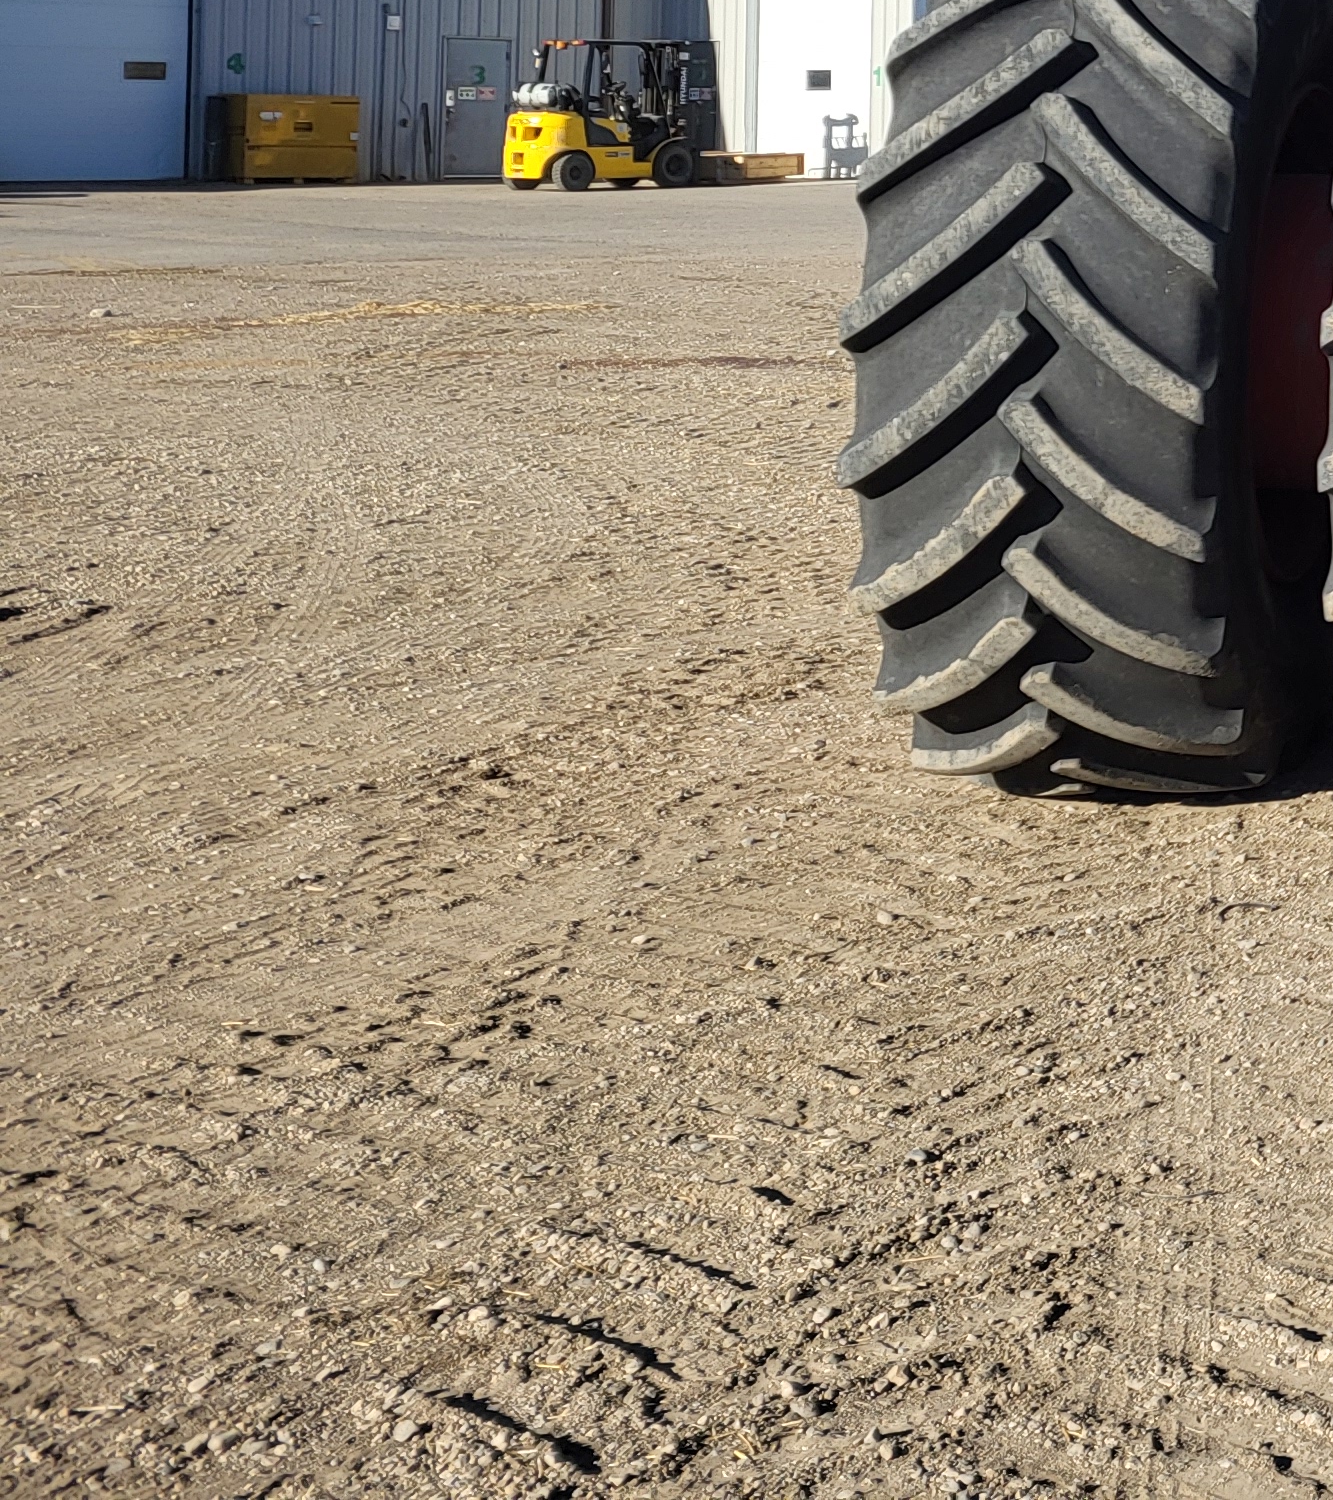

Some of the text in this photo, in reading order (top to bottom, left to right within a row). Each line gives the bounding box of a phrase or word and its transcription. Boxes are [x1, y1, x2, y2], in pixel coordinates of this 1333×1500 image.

[227, 52, 246, 75] 4
[469, 64, 486, 85] 3
[679, 66, 688, 105] HYUNDAI
[872, 65, 881, 87] 1
